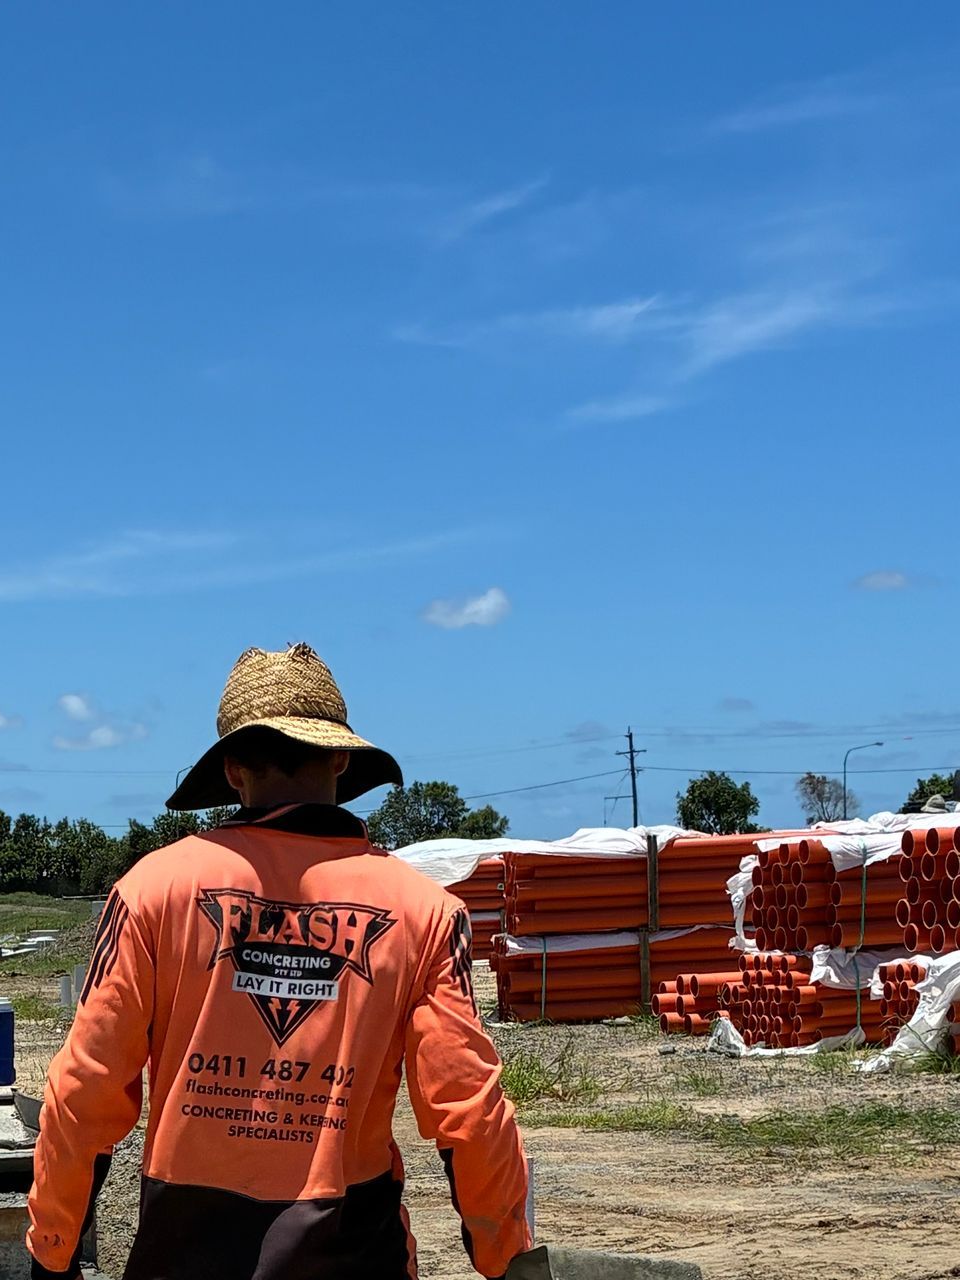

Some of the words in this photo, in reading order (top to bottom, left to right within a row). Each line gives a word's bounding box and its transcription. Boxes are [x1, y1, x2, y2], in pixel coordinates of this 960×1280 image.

[215, 894, 378, 968] FLASH
[241, 949, 332, 969] CONCRETING
[274, 968, 288, 976] PTY
[236, 974, 265, 991] LAY
[269, 979, 283, 994] IT
[289, 982, 336, 997] RIGHT
[188, 1053, 247, 1078] 0411
[260, 1058, 311, 1083] 487
[185, 1079, 349, 1108] flashconcreting.co.a
[181, 1104, 278, 1124] CONCRETING
[283, 1112, 294, 1125] &
[227, 1125, 314, 1143] SPECIALISTS
